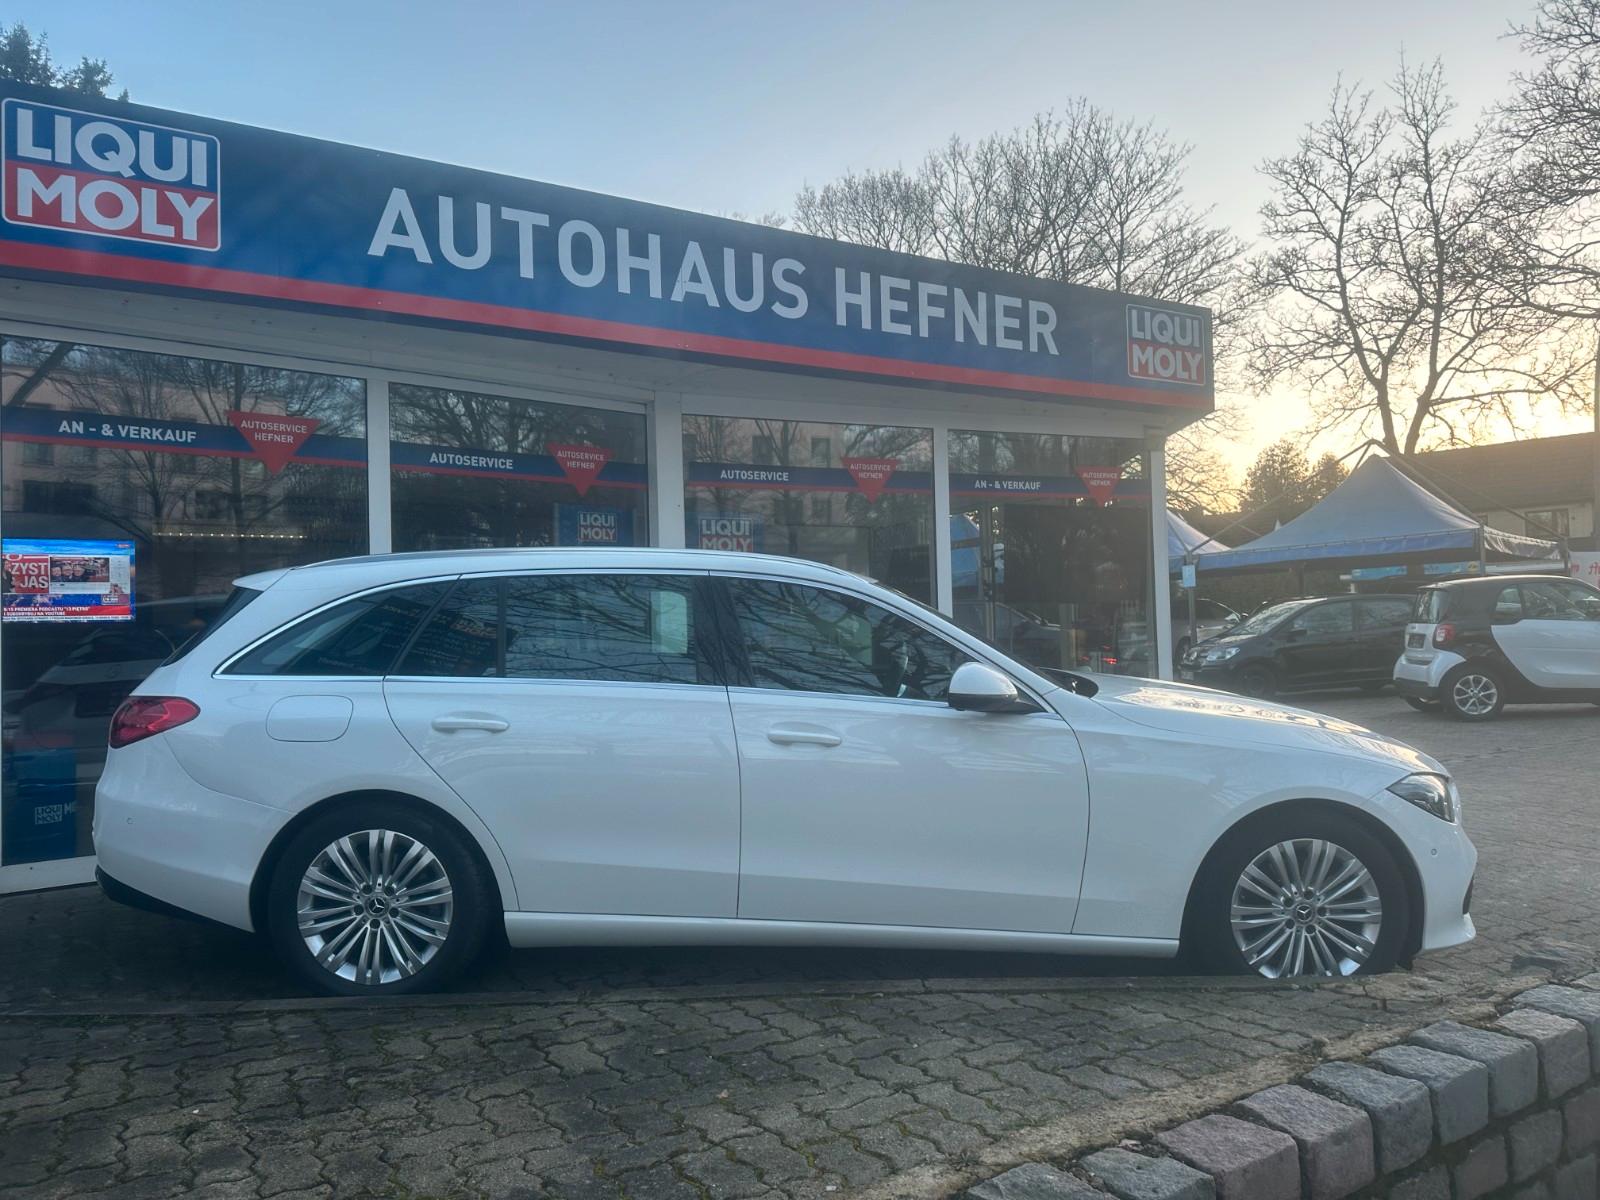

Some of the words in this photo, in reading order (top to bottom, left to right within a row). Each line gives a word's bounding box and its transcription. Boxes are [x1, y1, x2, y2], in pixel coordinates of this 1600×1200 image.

[17, 108, 207, 187] LIQUI
[17, 168, 214, 241] MOLY
[367, 187, 808, 320] AUTOHAUS
[836, 267, 1059, 355] HEFNER
[1131, 309, 1200, 347] LIQUI
[1132, 343, 1202, 380] MOLY
[58, 420, 82, 434] AN
[101, 423, 114, 437] &
[118, 425, 197, 443] VERKAUF
[240, 419, 308, 434] AUTOSERVICE
[254, 432, 294, 444] HEFNER
[429, 452, 514, 470] AUTOSERVICE
[557, 449, 605, 462] AUTOSERVICE
[567, 460, 595, 470] HEFNER
[850, 463, 891, 472] AUTOSERVICE
[720, 469, 789, 482] AUTOSERVICE
[974, 479, 987, 489] AN
[1002, 480, 1041, 491] VERKAUF
[579, 513, 615, 527] LIQUI
[580, 527, 616, 540] MOLY
[702, 519, 750, 536] LIQUI
[20, 575, 48, 588] JAS
